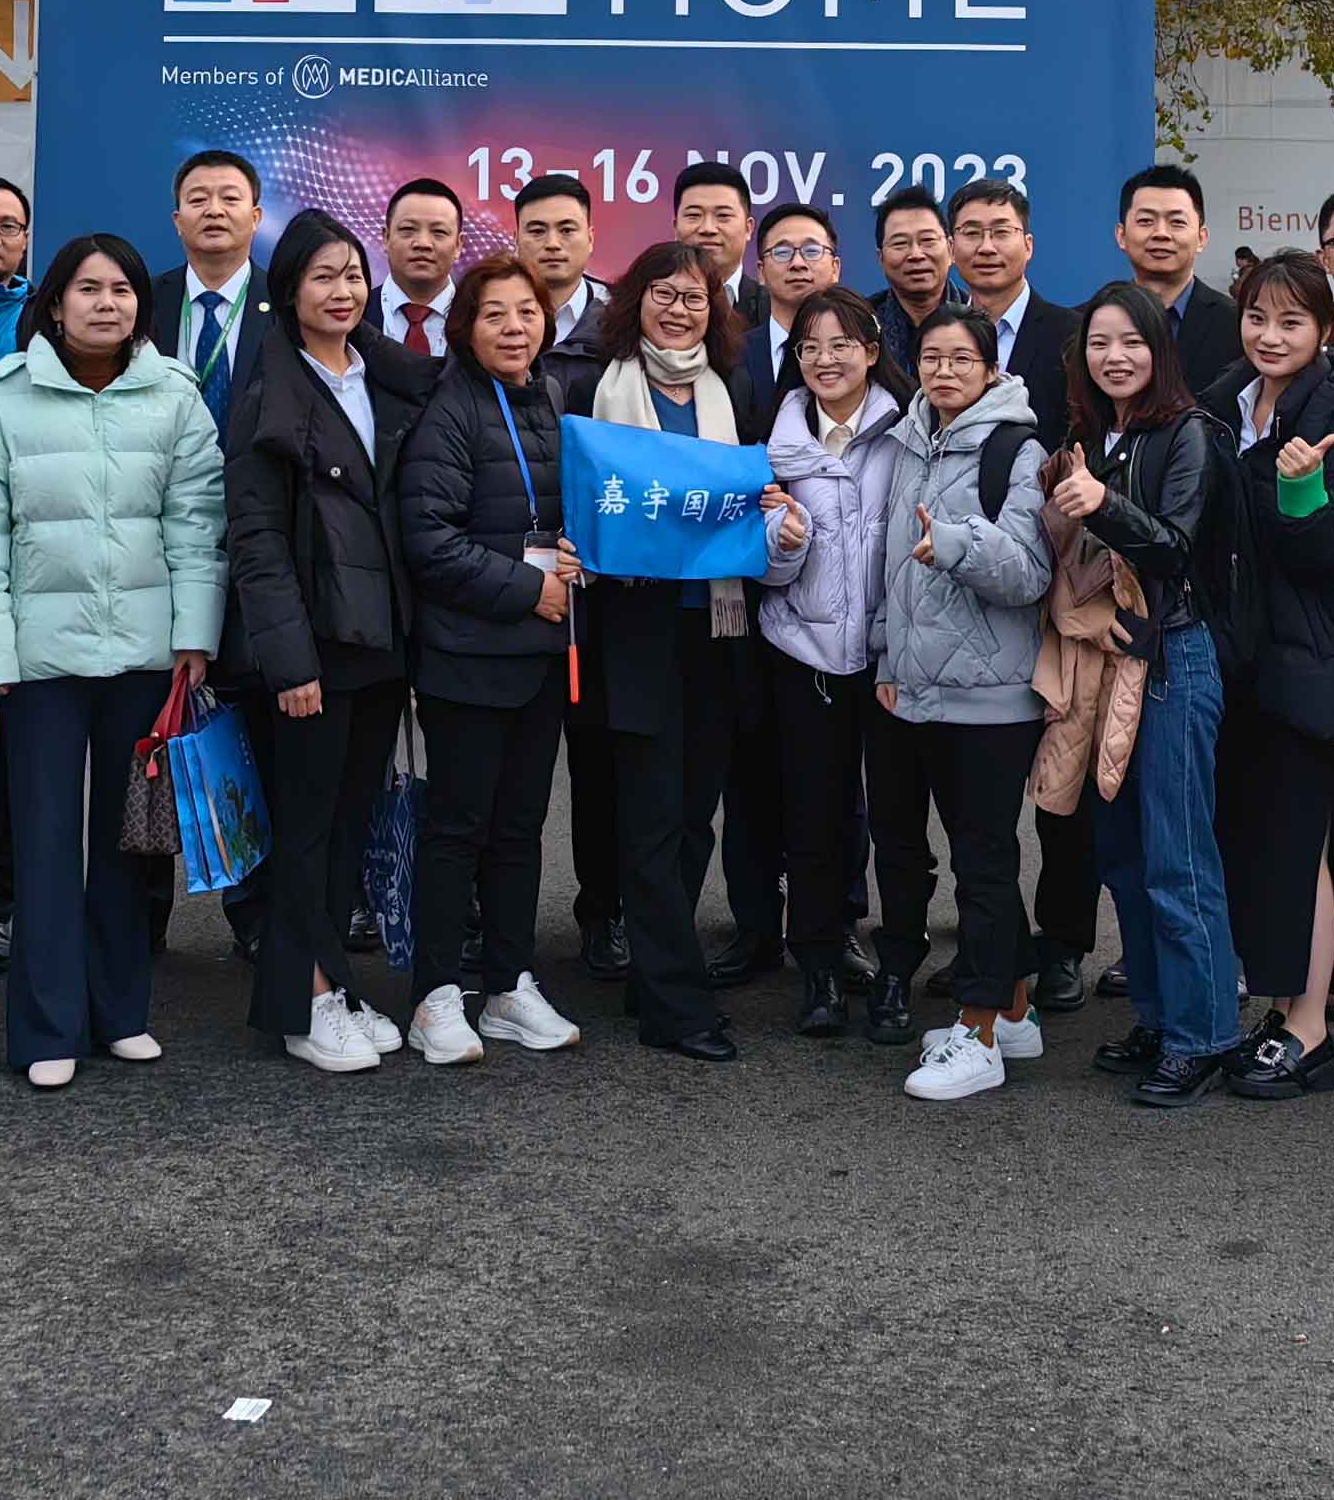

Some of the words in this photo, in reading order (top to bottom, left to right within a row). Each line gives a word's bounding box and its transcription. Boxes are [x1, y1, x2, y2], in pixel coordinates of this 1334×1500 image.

[161, 66, 258, 86] Members
[265, 66, 284, 85] of
[339, 67, 489, 88] MEDICAlliance
[687, 149, 845, 206] OV.
[594, 474, 748, 523] 嘉宇国际
